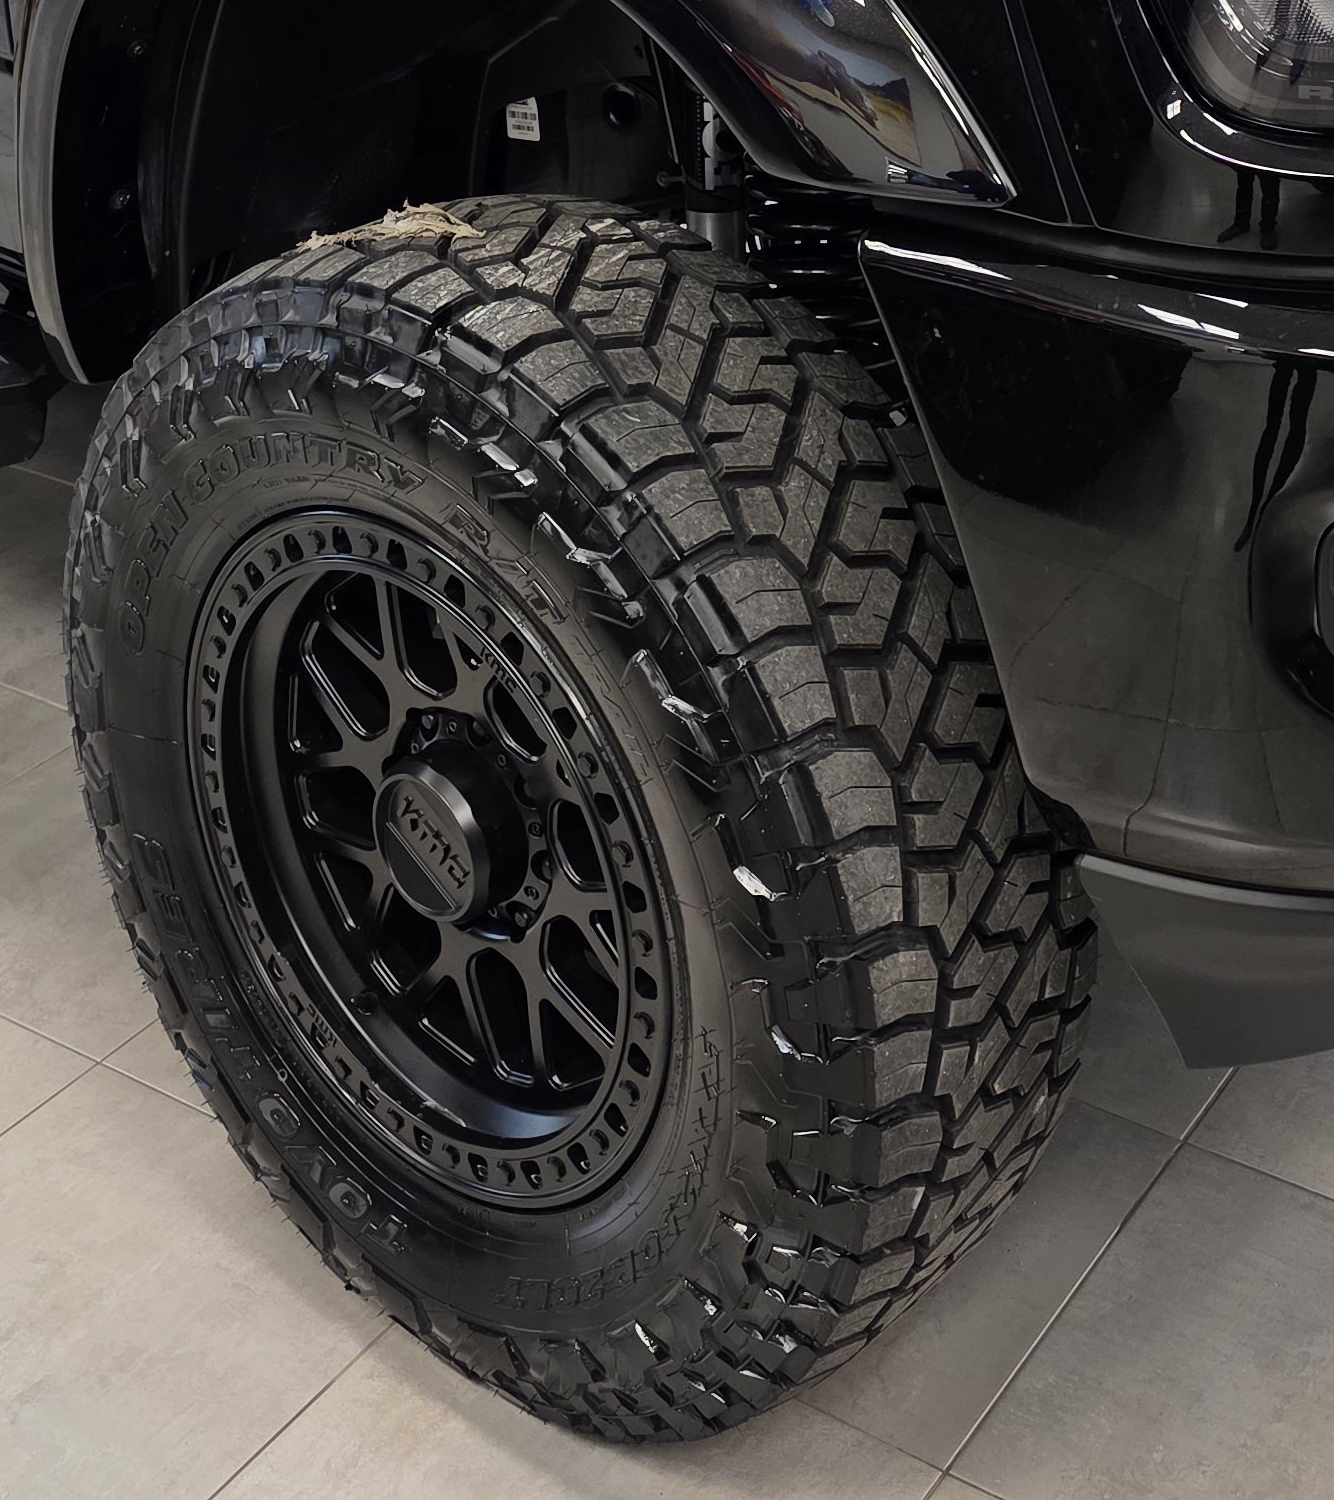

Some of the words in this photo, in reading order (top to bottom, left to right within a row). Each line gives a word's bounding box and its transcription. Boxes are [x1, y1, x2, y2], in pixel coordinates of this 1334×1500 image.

[118, 488, 189, 655] OPEN
[183, 431, 425, 505] COUNTRY
[258, 1090, 413, 1256] TOYO
